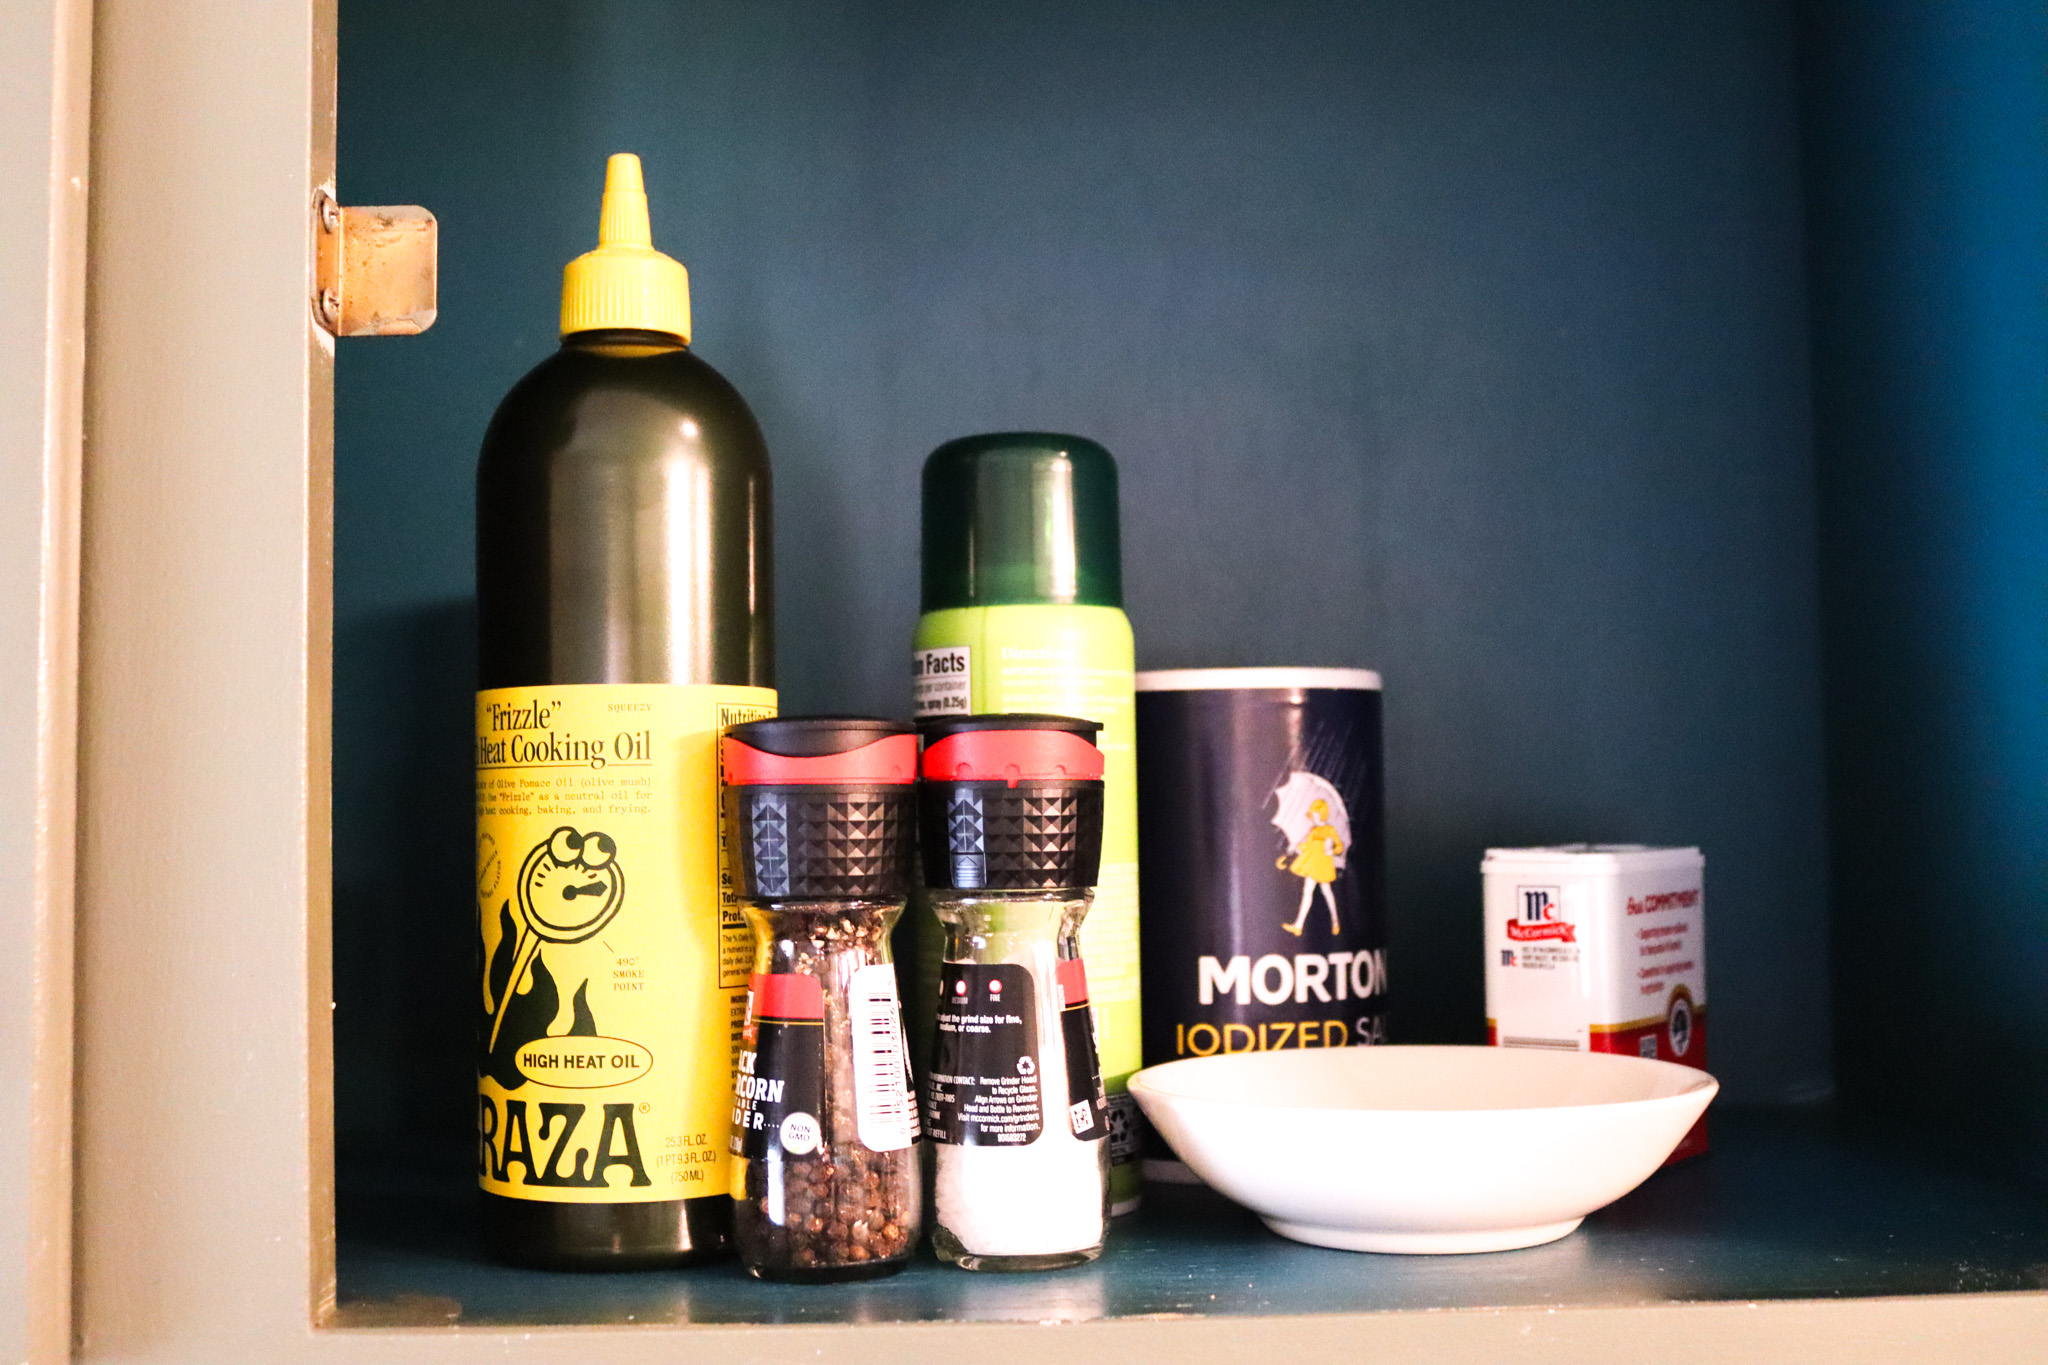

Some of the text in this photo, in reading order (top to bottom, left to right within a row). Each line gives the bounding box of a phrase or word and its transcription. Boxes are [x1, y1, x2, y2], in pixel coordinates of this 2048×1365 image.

[1001, 646, 1076, 660] Directi
[926, 652, 966, 675] Facts
[607, 703, 652, 713] SQUEEZY
[480, 730, 652, 769] Heat Cooking Oil
[497, 778, 516, 789] Olive
[519, 779, 551, 788] Pomace
[555, 778, 574, 787] Oil
[580, 777, 615, 788] (olive
[620, 776, 651, 787] mush)
[538, 793, 550, 801] as
[554, 793, 560, 801] a
[564, 790, 605, 801] neutral
[610, 789, 632, 800] oil
[636, 789, 653, 800] for
[499, 805, 533, 817] cooking,
[536, 805, 577, 816] baking,
[582, 805, 603, 815] and
[608, 804, 652, 816] frying.
[722, 907, 745, 921] Prot
[1509, 926, 1566, 939] McCormick
[613, 970, 645, 979] SMOKE
[1198, 949, 1388, 1006] MORTON
[613, 982, 645, 991] POINT
[989, 993, 1001, 1002] FINE
[961, 1014, 979, 1025] grind
[980, 1014, 994, 1024] size
[994, 1014, 1005, 1024] for
[1005, 1014, 1023, 1025] fine,
[957, 1024, 966, 1033] or
[966, 1025, 992, 1034] coarse.
[1176, 1019, 1349, 1057] IODIZED
[523, 1053, 640, 1069] HIGH HEAT OIL
[953, 1075, 976, 1086] CONTACT:
[979, 1075, 1037, 1086] Remove Grinder Head
[991, 1084, 1038, 1096] to Recycle Glass.
[974, 1094, 1038, 1105] Align Arrows on Grinder
[963, 1103, 1039, 1114] Head and Bottle to Remove.
[957, 1112, 1040, 1124] Visit mccormick.com/grinders
[790, 1123, 811, 1134] NON
[980, 1122, 1041, 1133] for more information.
[788, 1132, 811, 1142] GMO
[933, 1129, 947, 1140] REFILL
[665, 1153, 677, 1165] PT
[689, 1169, 705, 1183] ML)
